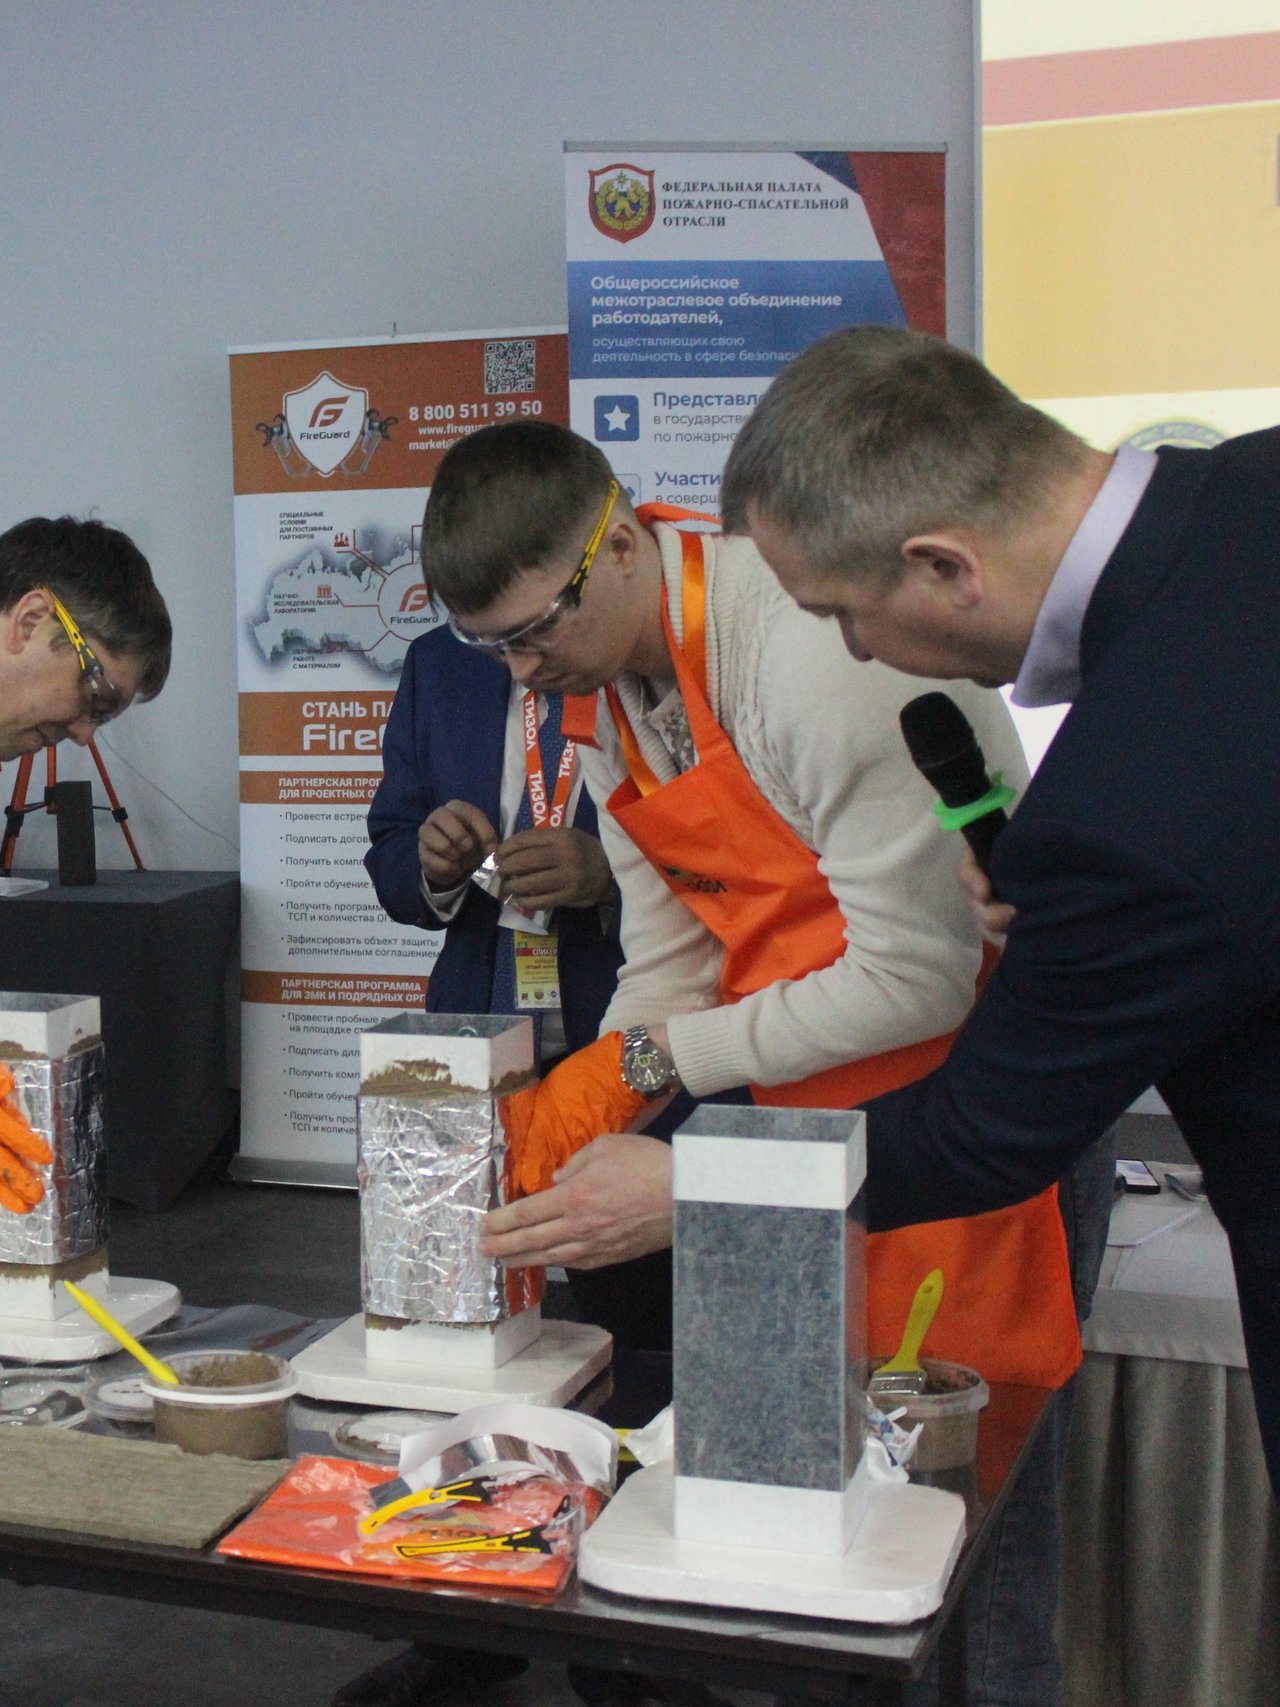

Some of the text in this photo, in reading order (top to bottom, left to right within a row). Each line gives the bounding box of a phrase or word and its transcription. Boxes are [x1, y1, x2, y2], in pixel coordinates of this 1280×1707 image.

[662, 182, 821, 193] ФЕДЕРАЛЬНАЯ ПАЛАТА
[663, 198, 849, 209] ПОЖАРНО-СПАСАТЕЛЬНОЙ
[663, 217, 726, 227] ОТРАСЛИ
[591, 276, 739, 291] Общероссийское
[592, 293, 842, 309] межотраслевое объединение
[592, 311, 723, 327] работодателей,
[593, 337, 745, 349] осуществляющих свою
[593, 352, 681, 363] деятельность
[685, 352, 692, 360] в
[695, 350, 735, 362] сфере
[654, 392, 760, 410] Представл
[409, 400, 542, 421] 8 800 511 39 50
[654, 416, 661, 424] в
[300, 430, 350, 440] FireGuard
[654, 433, 671, 442] по
[409, 437, 461, 450] market@
[656, 495, 663, 503] в
[390, 616, 438, 624] FireGuard
[302, 702, 367, 718] СТАНЬ
[524, 697, 536, 752] ТИЗОЛ
[279, 778, 352, 787] ПАРТНЕРСКАЯ
[279, 790, 377, 799] ДЛЯ ПРОЕКТНЫХ О
[529, 770, 547, 825] ТИЗОЛ
[285, 812, 331, 822] Провести
[285, 834, 337, 844] Подписать
[285, 857, 331, 867] Получить
[286, 879, 320, 889] Пройти
[324, 880, 369, 890] обучение
[286, 902, 386, 912] Получить программ
[288, 912, 308, 921] ТСП
[318, 914, 374, 922] количества
[286, 935, 438, 947] Зафиксировать объект защиты
[288, 947, 372, 956] дополнительным
[281, 978, 421, 991] ПАРТНЕРСКАЯ ПРОГРАММА
[281, 990, 302, 1000] ДЛЯ
[304, 991, 326, 999] ЗМК
[328, 992, 336, 1000] И
[338, 992, 403, 1002] ПОДРЯДНЫХ
[288, 1012, 333, 1022] Провести
[336, 1014, 378, 1024] пробные
[289, 1025, 301, 1033] на
[303, 1025, 352, 1034] площадке
[288, 1046, 360, 1057] Подписать дил
[289, 1068, 360, 1078] Получить комп
[289, 1089, 325, 1100] Пройти
[289, 1111, 334, 1122] Получить
[292, 1123, 311, 1132] ТСП
